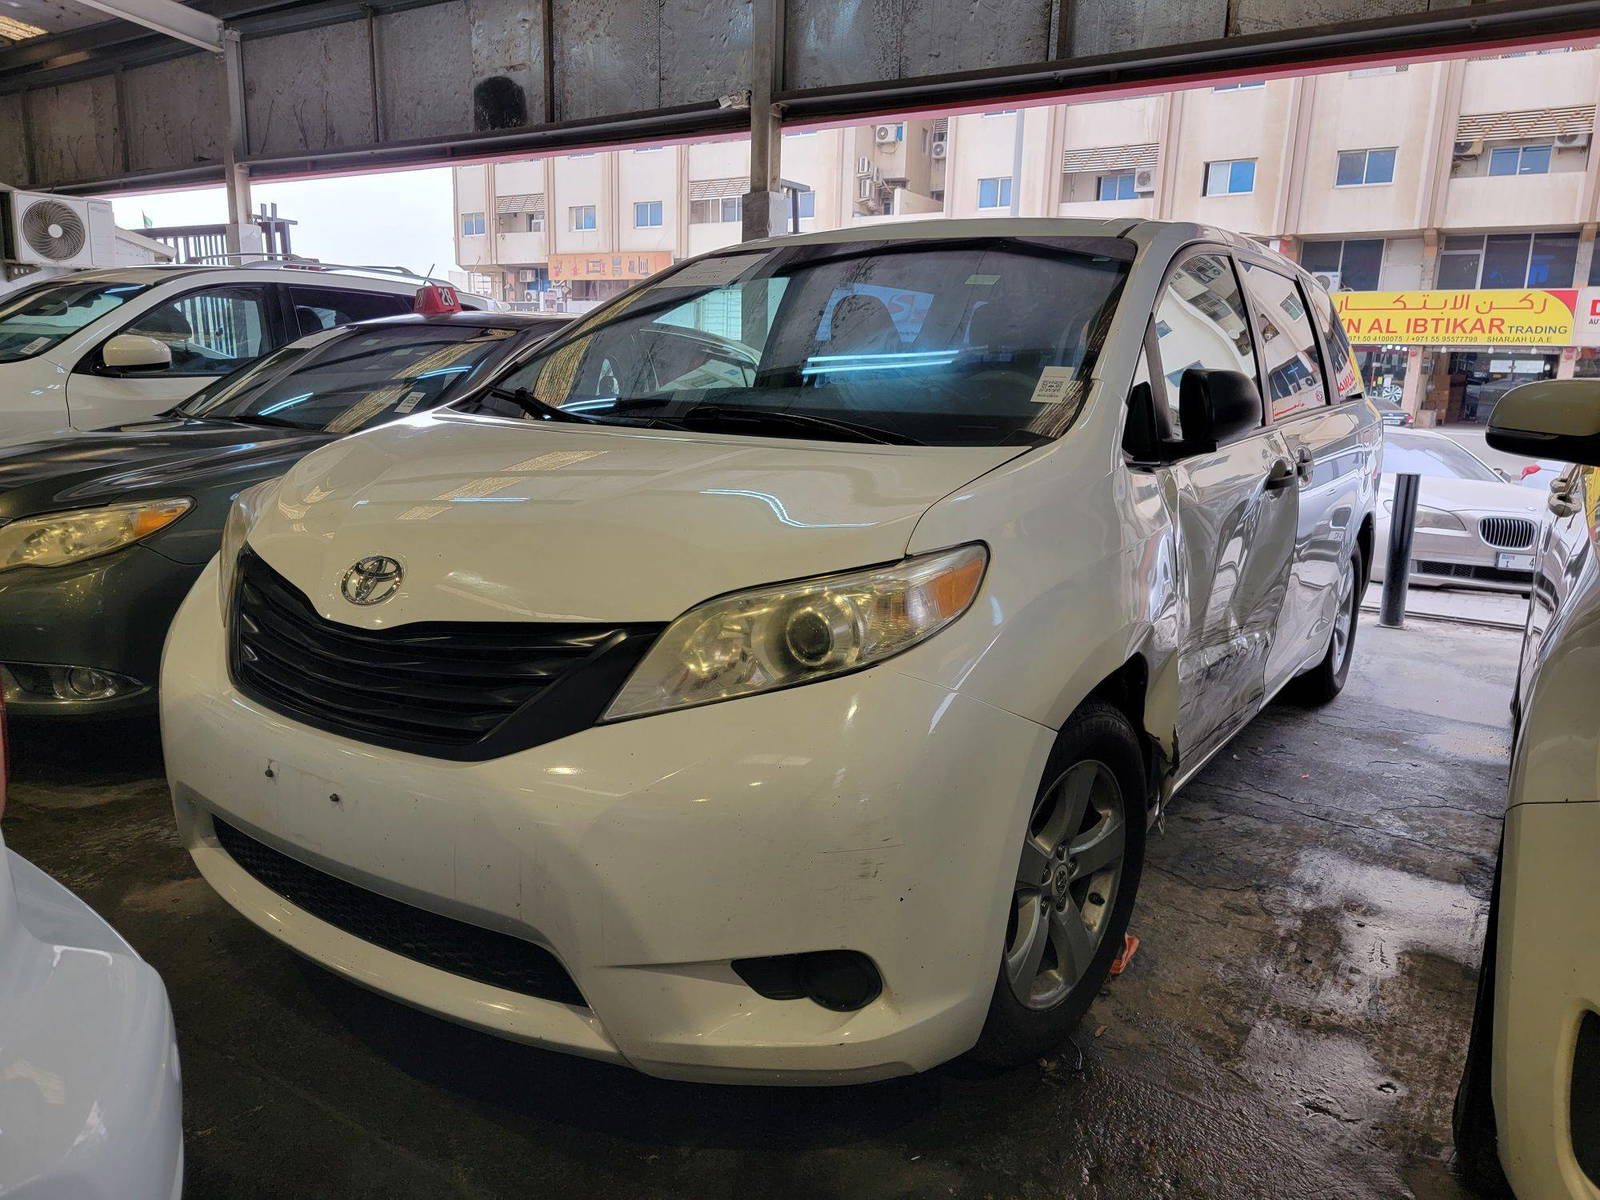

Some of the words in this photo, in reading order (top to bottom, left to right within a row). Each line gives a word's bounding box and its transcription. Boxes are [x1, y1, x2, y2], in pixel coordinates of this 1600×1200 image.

[438, 287, 454, 306] 28
[1475, 293, 1547, 315] ركن
[1341, 318, 1362, 334] N
[1367, 318, 1398, 334] AL
[1406, 317, 1505, 334] IBTIKAR
[1507, 325, 1568, 335] TRADING
